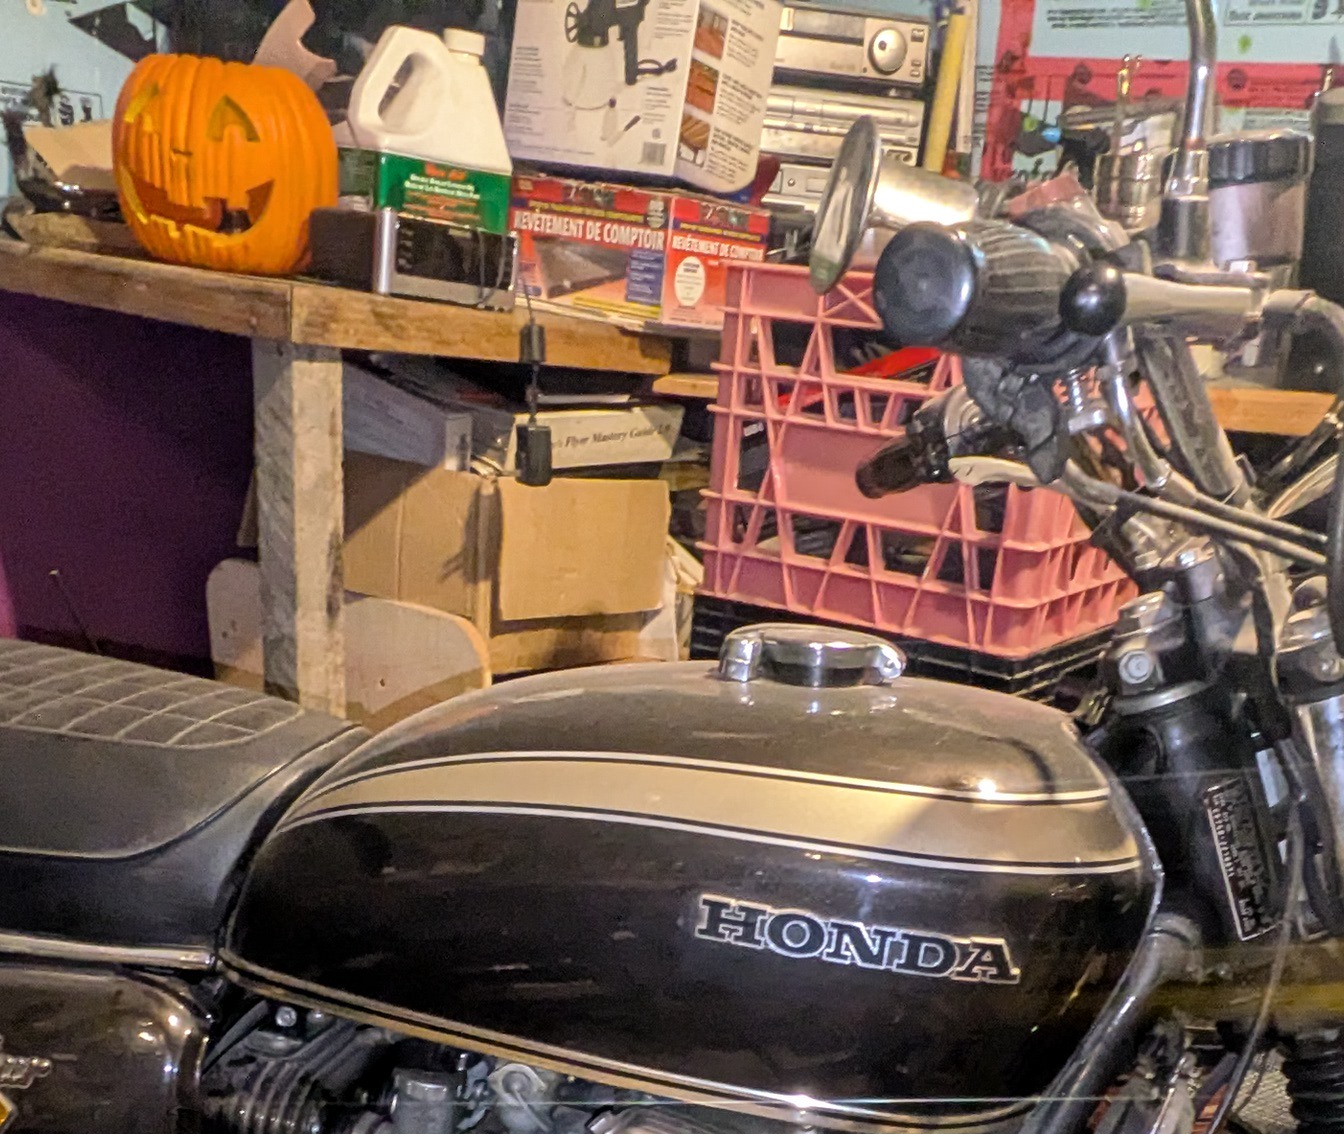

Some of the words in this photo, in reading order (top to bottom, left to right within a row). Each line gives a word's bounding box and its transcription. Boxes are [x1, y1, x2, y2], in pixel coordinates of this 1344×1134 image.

[586, 220, 602, 242] DE
[603, 222, 665, 251] COMPTOIR
[695, 894, 1021, 984] HONDA
